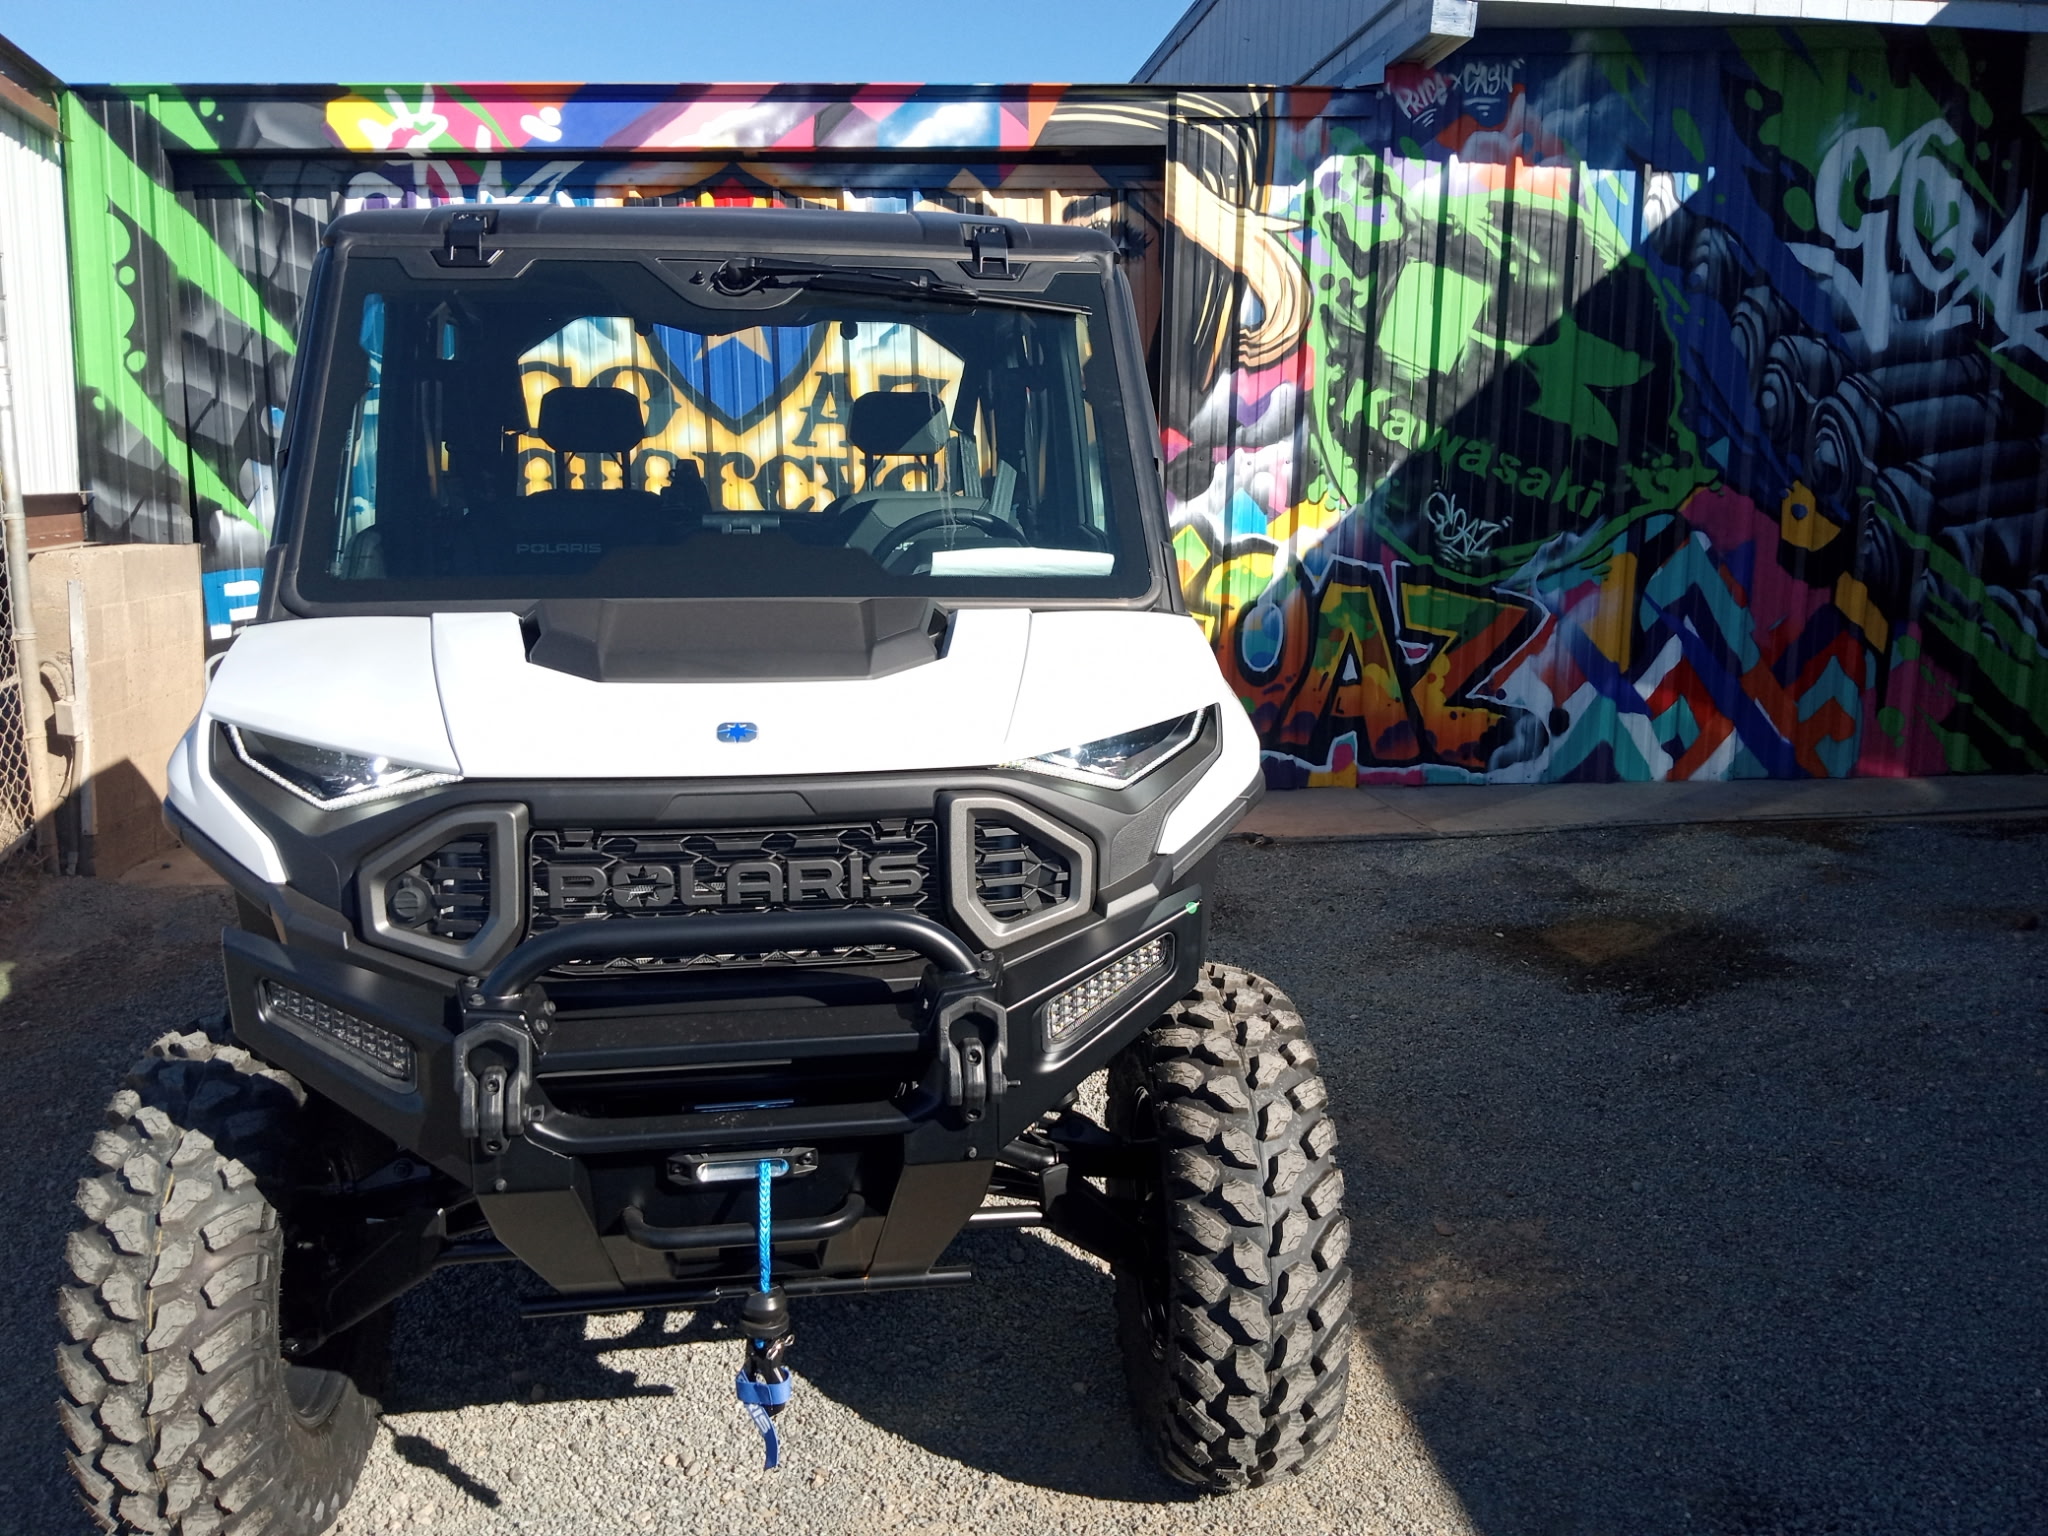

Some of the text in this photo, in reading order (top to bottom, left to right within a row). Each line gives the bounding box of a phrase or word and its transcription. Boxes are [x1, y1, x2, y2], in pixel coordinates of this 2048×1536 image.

[1339, 379, 1606, 519] Kawasaki
[515, 543, 603, 553] POLARIS
[548, 854, 924, 910] POLARIS
